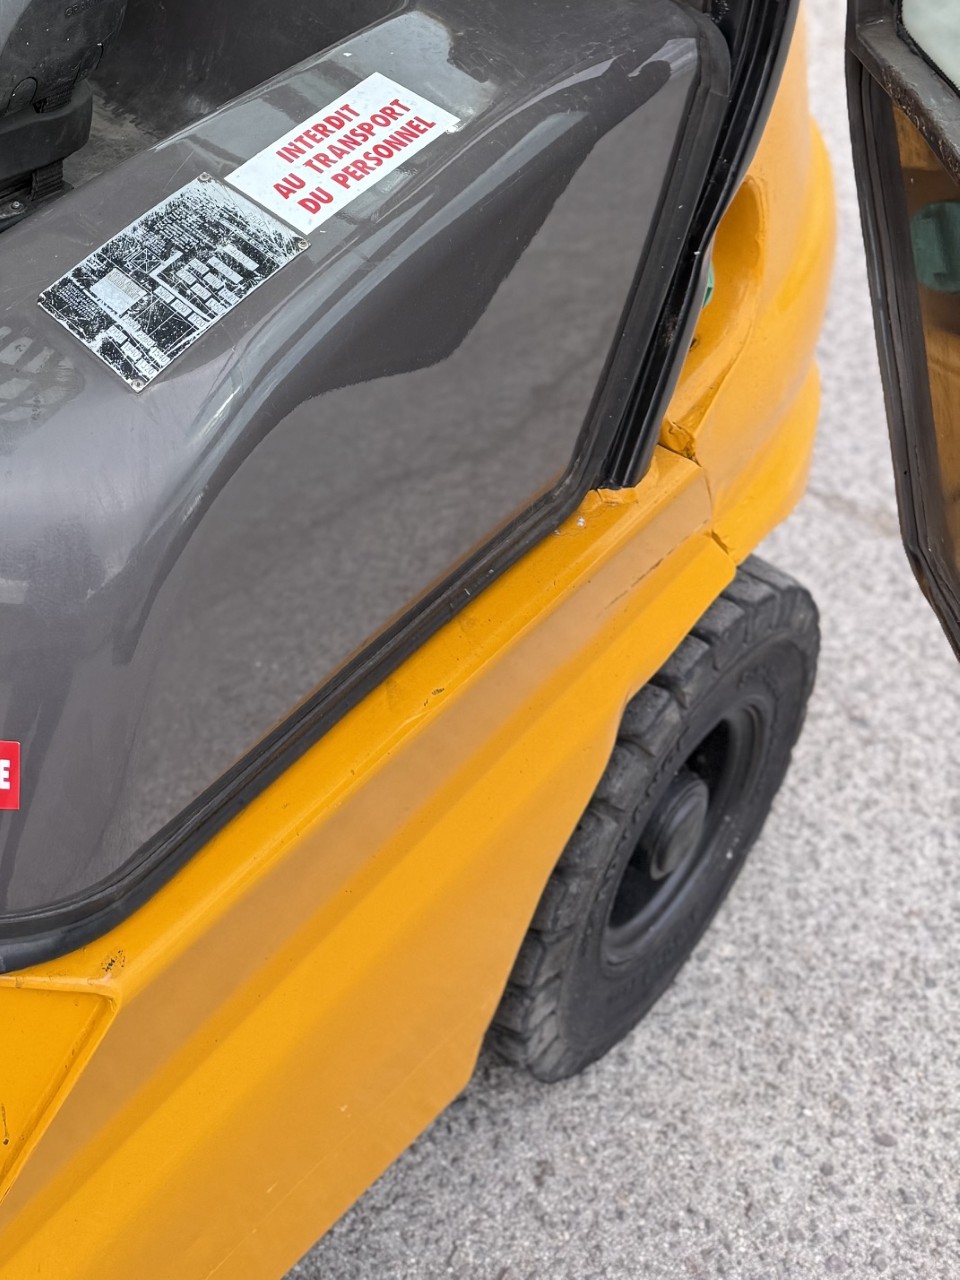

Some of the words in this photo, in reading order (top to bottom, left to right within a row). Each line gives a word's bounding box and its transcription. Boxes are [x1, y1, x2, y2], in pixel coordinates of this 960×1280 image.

[273, 173, 306, 199] AU
[303, 99, 411, 174] TRANSPORT
[276, 104, 360, 163] INTERDIT
[297, 187, 334, 214] DU
[331, 116, 436, 189] PERSONNEL
